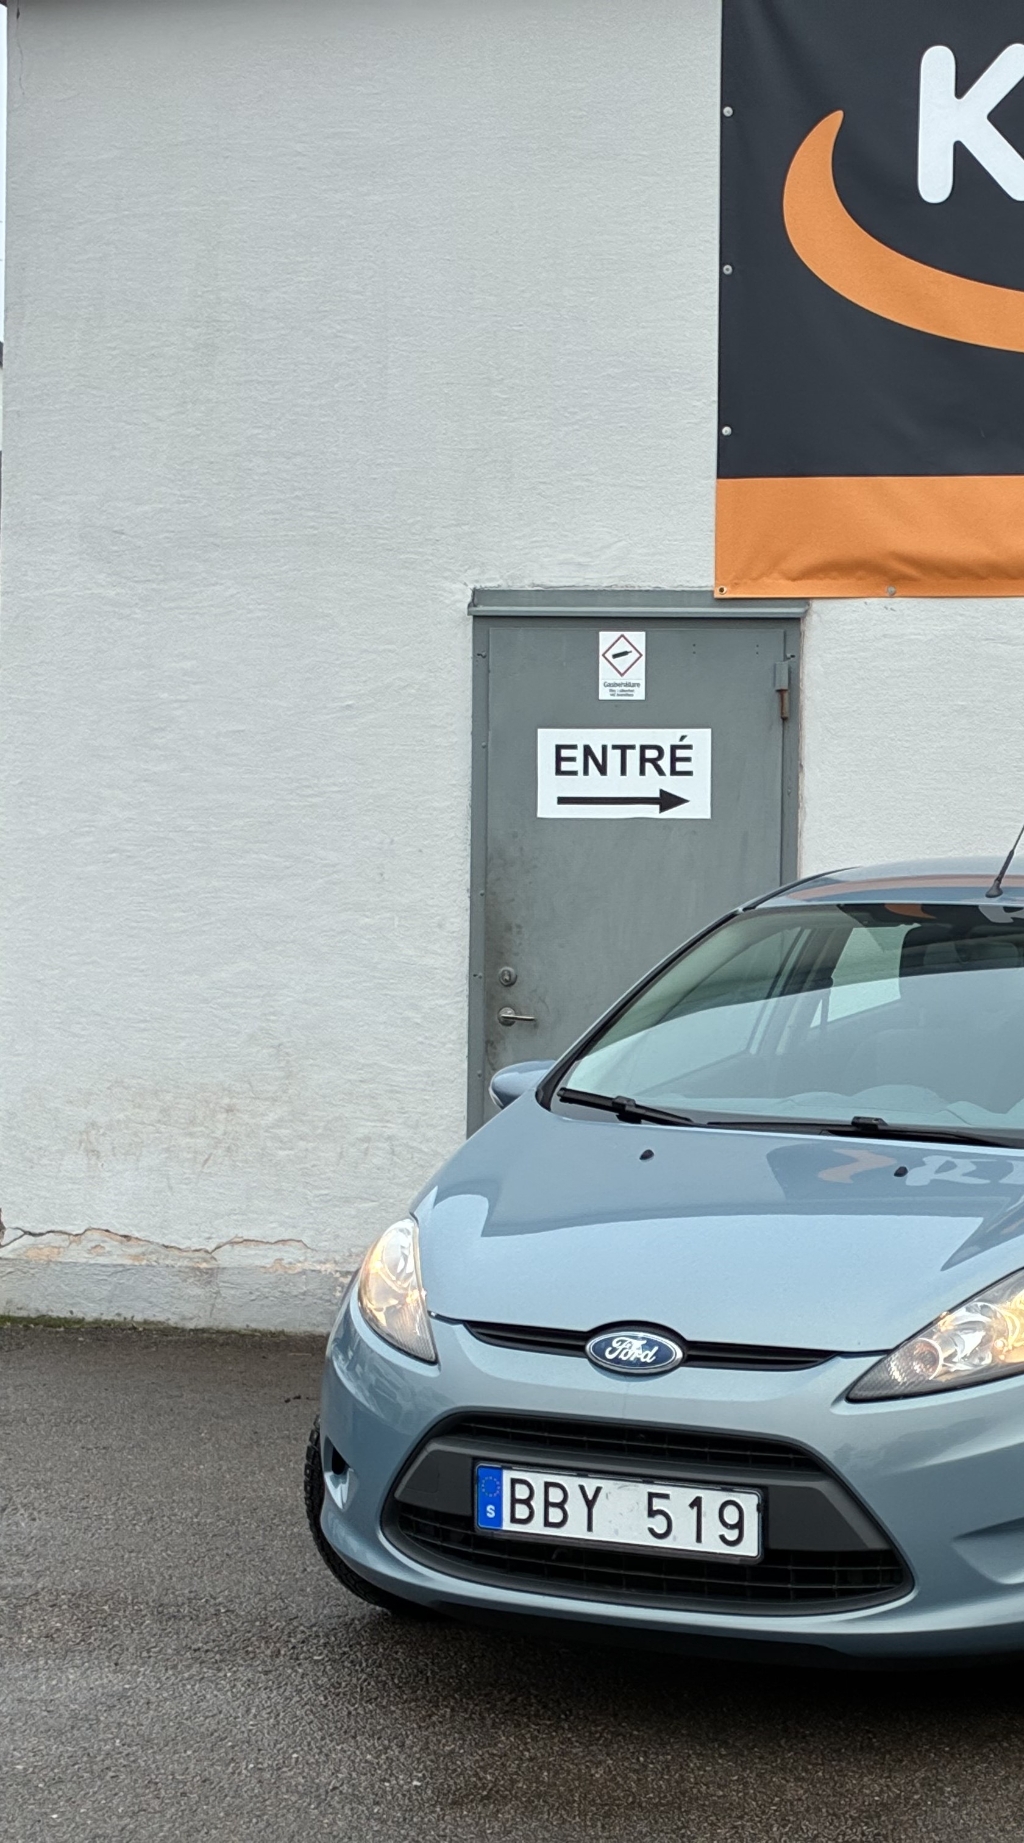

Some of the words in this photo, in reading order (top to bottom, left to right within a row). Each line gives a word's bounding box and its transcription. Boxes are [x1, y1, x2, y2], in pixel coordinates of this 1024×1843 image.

[554, 734, 694, 777] ENTRÉ
[605, 1337, 659, 1363] Ford
[486, 1504, 496, 1518] S
[509, 1477, 603, 1533] BBY
[647, 1491, 745, 1547] 519
